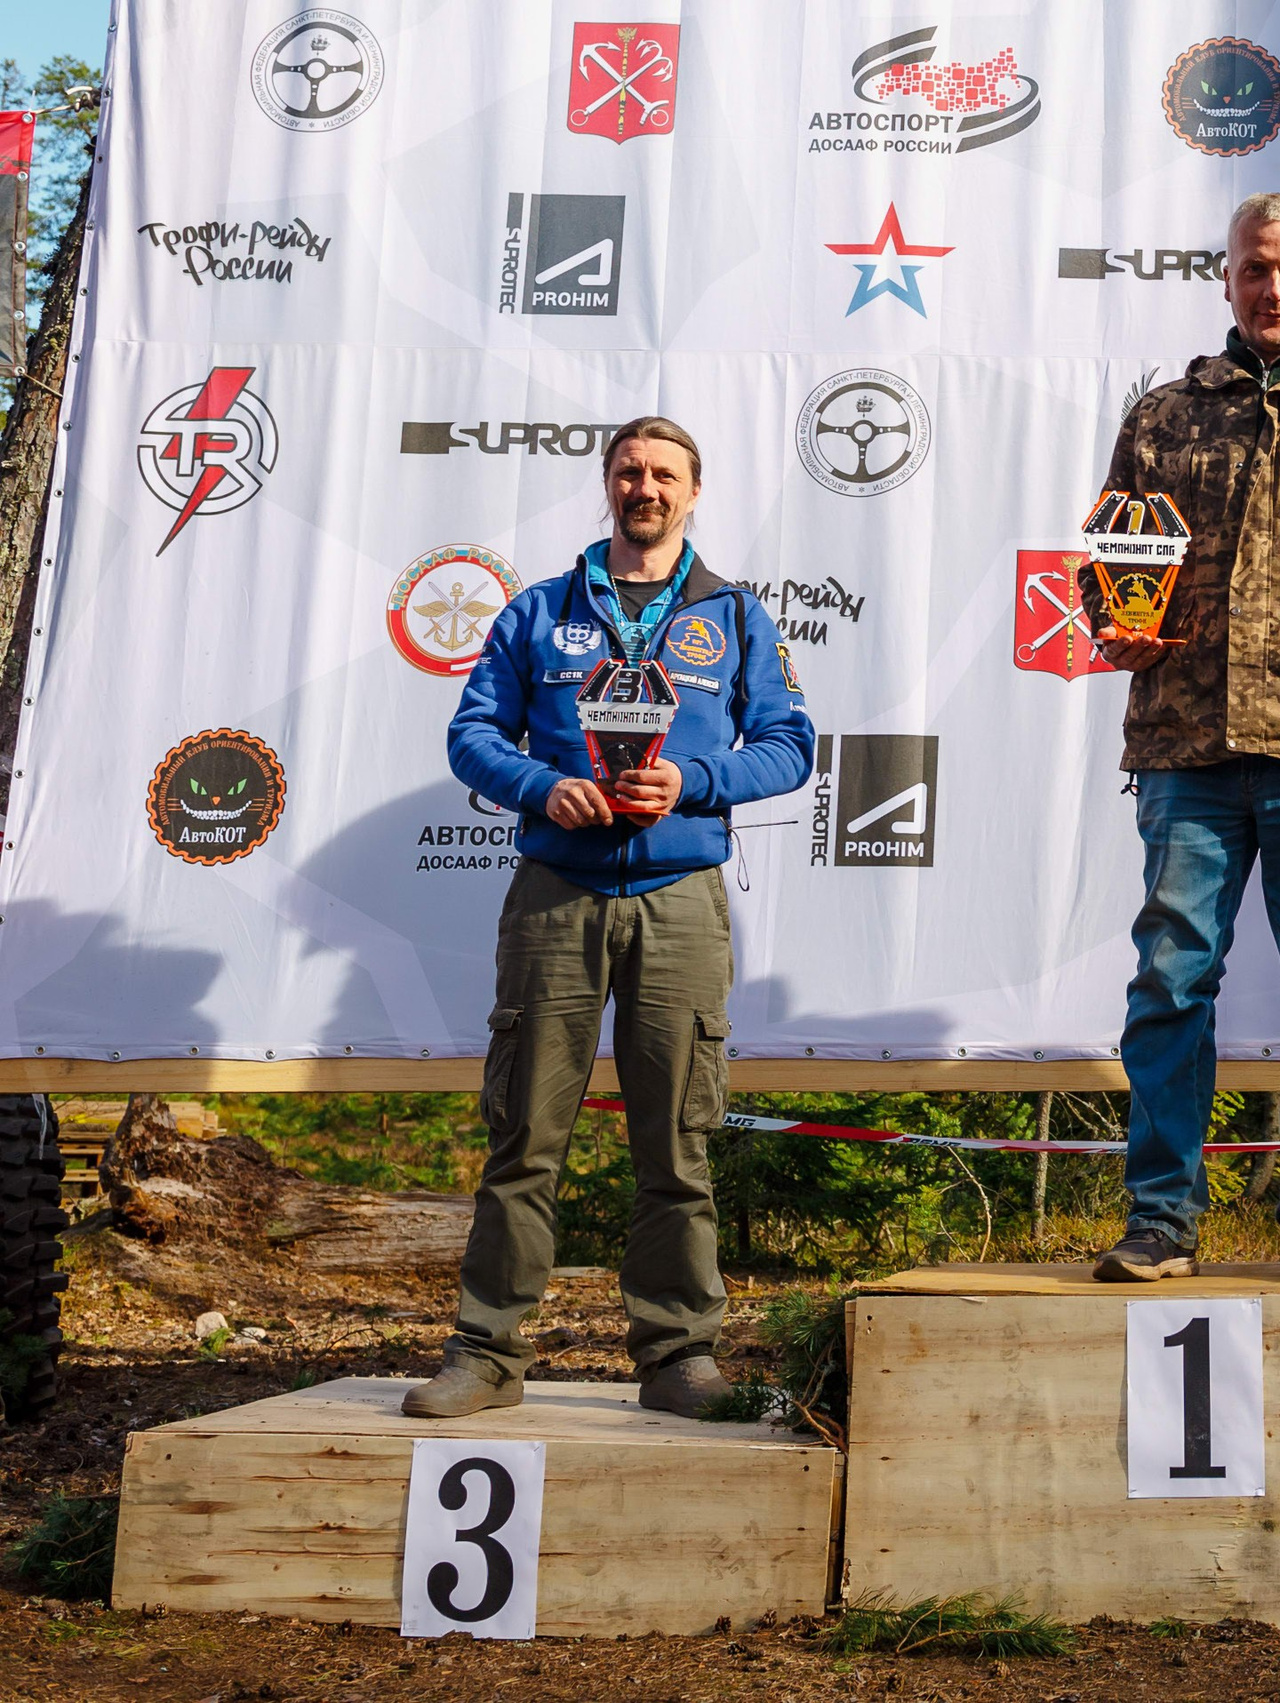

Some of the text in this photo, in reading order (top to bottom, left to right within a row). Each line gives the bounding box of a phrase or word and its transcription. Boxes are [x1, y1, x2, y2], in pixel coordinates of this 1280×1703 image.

[286, 11, 363, 34] САНКТ-ПЕТЕРБУРГА
[255, 28, 286, 72] ФЕДЕРАЦИЯ
[359, 37, 380, 107] ЛЕНИНГРАДСКОЙ
[254, 75, 301, 127] АВТОМОБИЛЬНАЯ
[323, 107, 360, 128] ОБЛАСТИ
[808, 112, 954, 133] АВТОСПОРТ
[808, 139, 952, 154] ДОСААФ РОССИИ
[137, 217, 332, 262] Трофи-рейды
[183, 246, 293, 285] России
[499, 227, 521, 314] SUPROTEC
[1104, 248, 1228, 281] SUPR
[532, 291, 609, 307] PROHIM
[827, 371, 908, 394] САНКТ-ПЕТЕРБУРГА
[801, 387, 827, 434] ФЕДЕРАЦИЯ
[448, 421, 624, 457] SUPROT
[908, 397, 927, 469] ЛЕНИНГРАДСКОЙ
[799, 436, 850, 492] АВТОМОБИЛЬНАЯ
[873, 468, 910, 492] ОБЛАСТИ
[390, 547, 521, 608] ДОСААФ РОССИ
[811, 772, 832, 867] SUPROTEC
[416, 855, 492, 872] ДОСААФ
[844, 841, 925, 857] PROHIM
[1163, 1316, 1228, 1479] 1
[427, 1456, 517, 1623] 3
